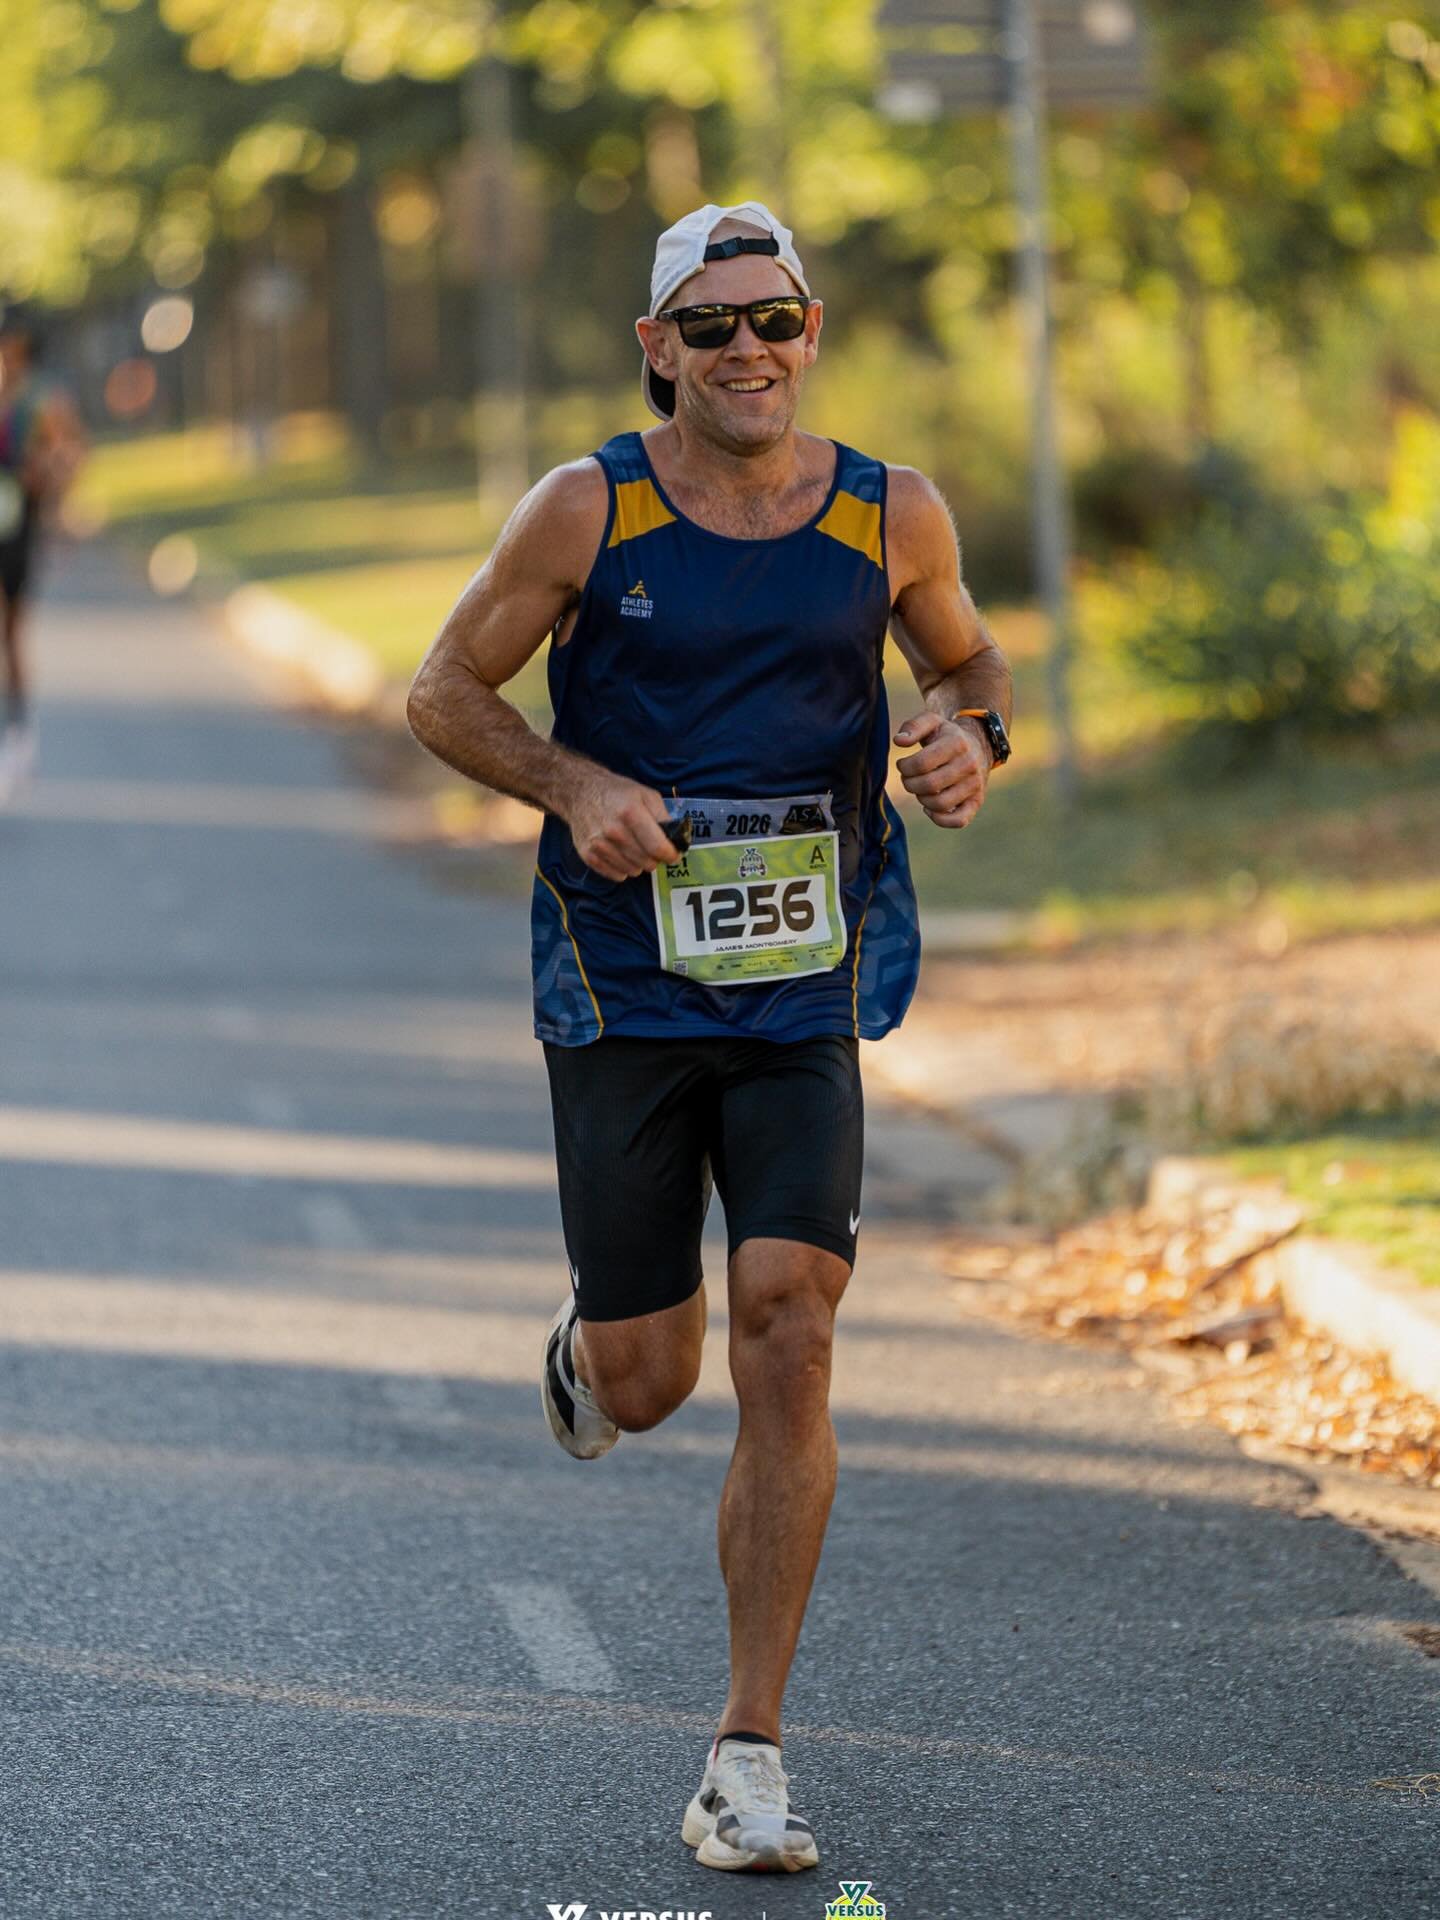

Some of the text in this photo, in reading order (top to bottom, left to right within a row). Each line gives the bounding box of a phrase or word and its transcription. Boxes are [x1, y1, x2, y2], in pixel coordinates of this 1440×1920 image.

[620, 596, 654, 609] ATHLETES
[620, 606, 652, 619] ACADEMY
[785, 807, 823, 824] ASA
[726, 814, 771, 836] 2026
[810, 845, 825, 864] A
[666, 856, 688, 868] 1
[666, 868, 690, 878] KM
[685, 880, 815, 942] 1256
[714, 939, 797, 952] JAMES MONTGOMERY
